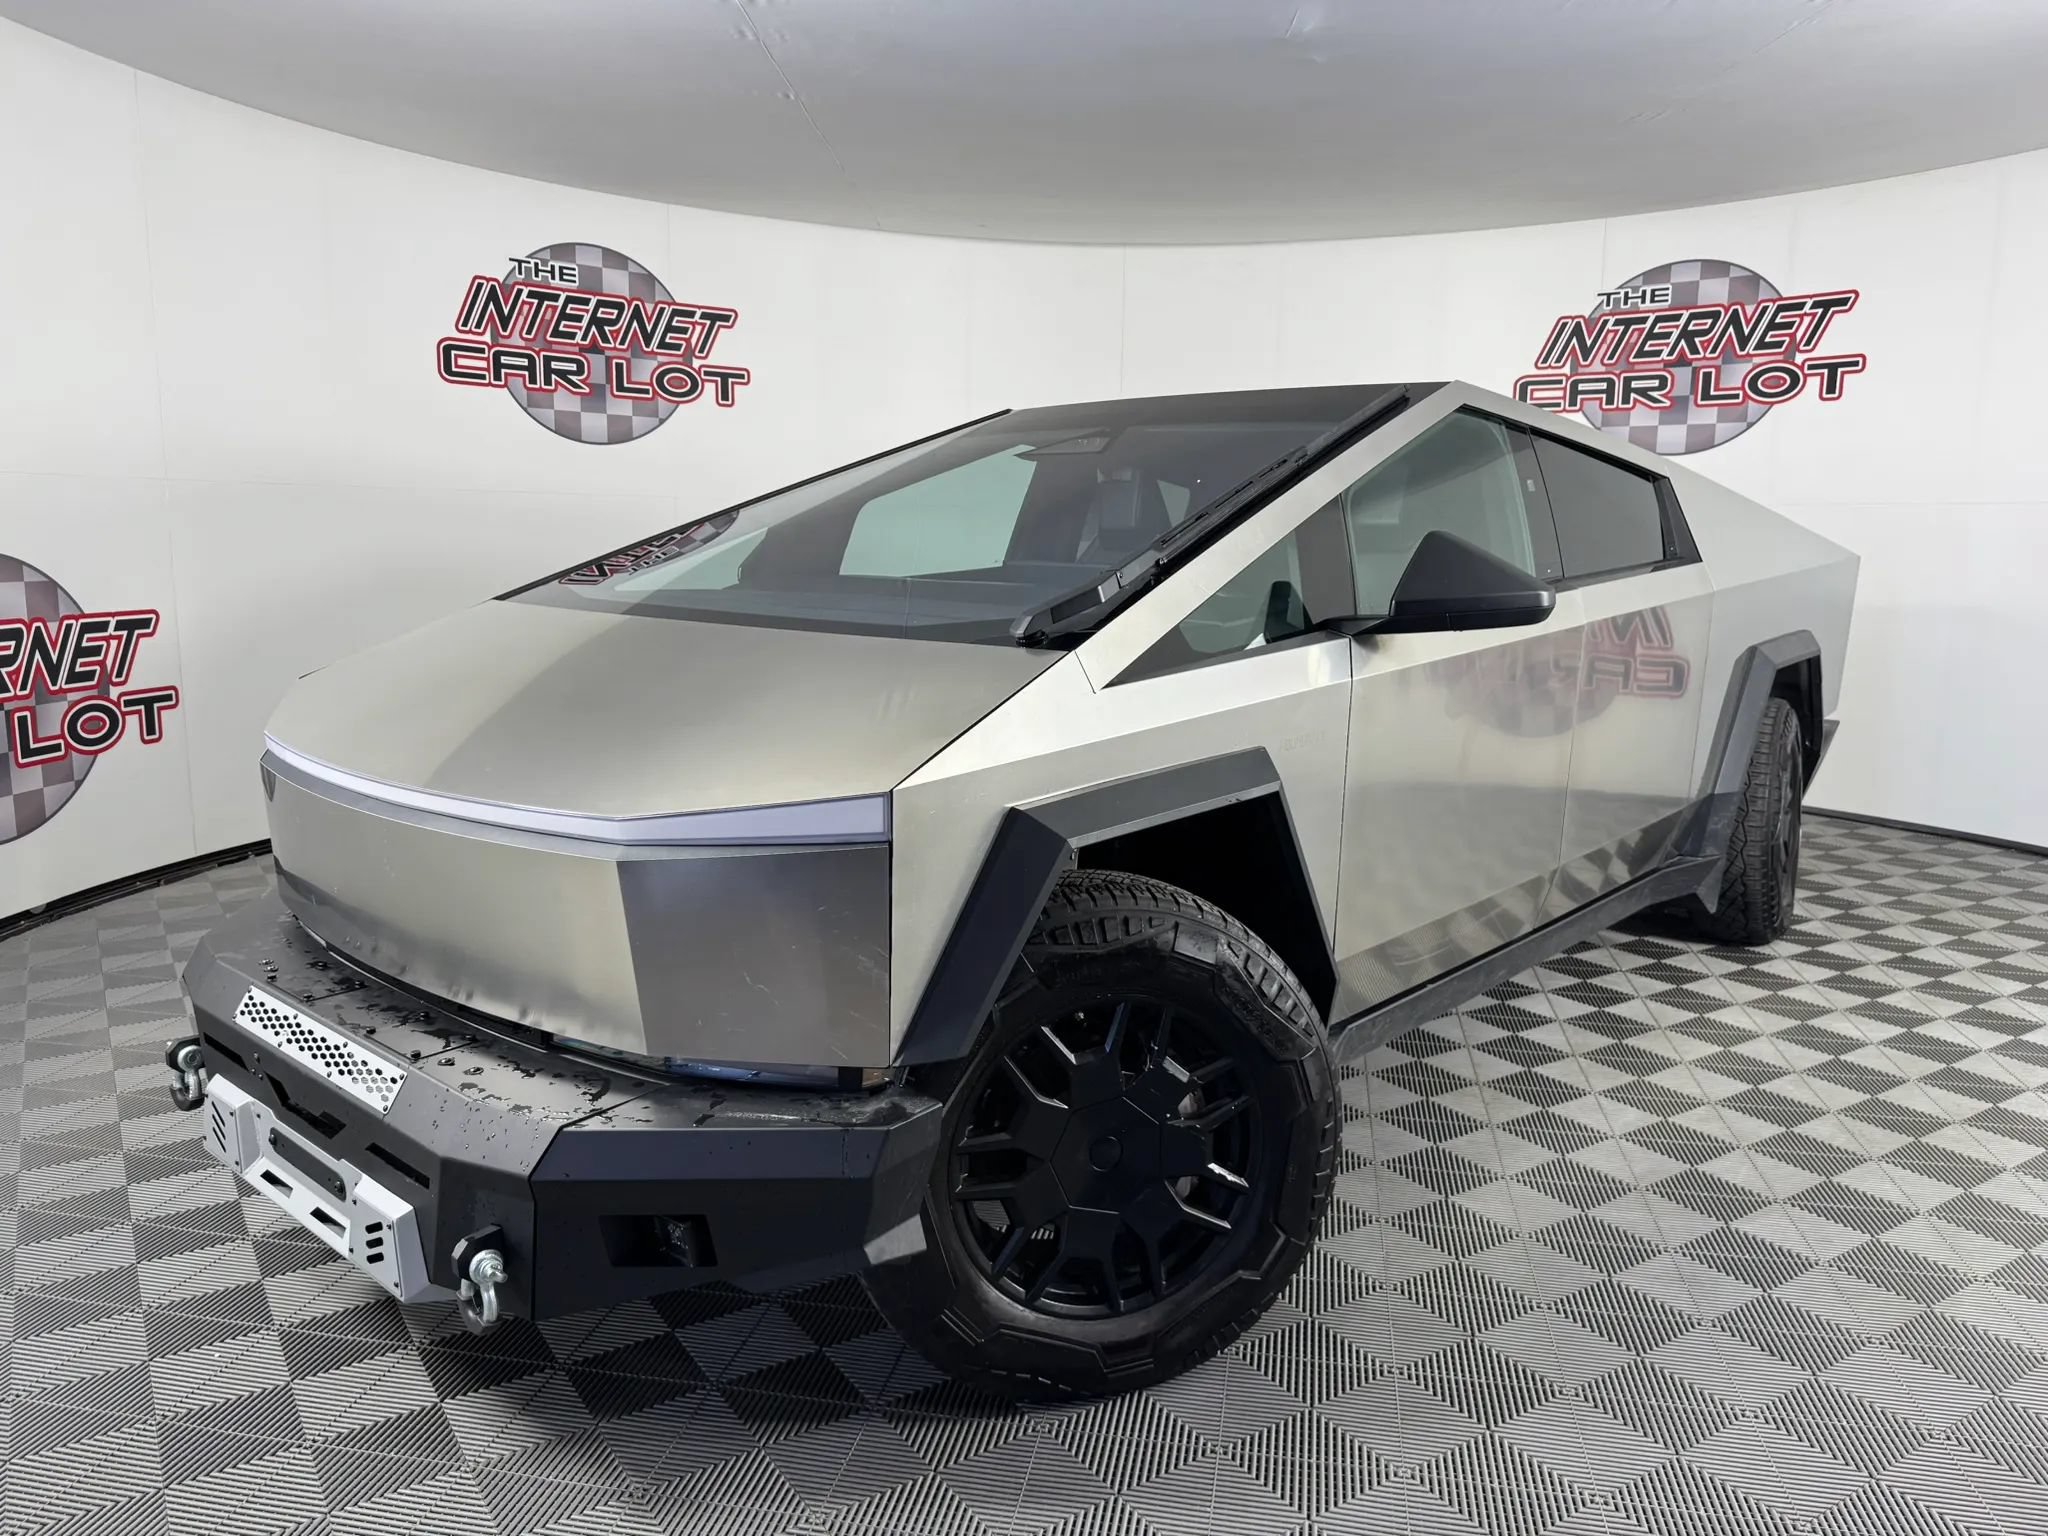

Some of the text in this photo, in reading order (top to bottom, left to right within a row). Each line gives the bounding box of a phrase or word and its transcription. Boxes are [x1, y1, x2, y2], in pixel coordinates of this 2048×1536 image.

[507, 256, 578, 285] THE
[1598, 286, 1671, 308] THE
[458, 278, 736, 357] INTERNET
[1537, 292, 1856, 367] INTERNET
[440, 340, 748, 405] CAR LOT
[1516, 357, 1863, 409] CAR LOT
[13, 689, 176, 763] LOT
